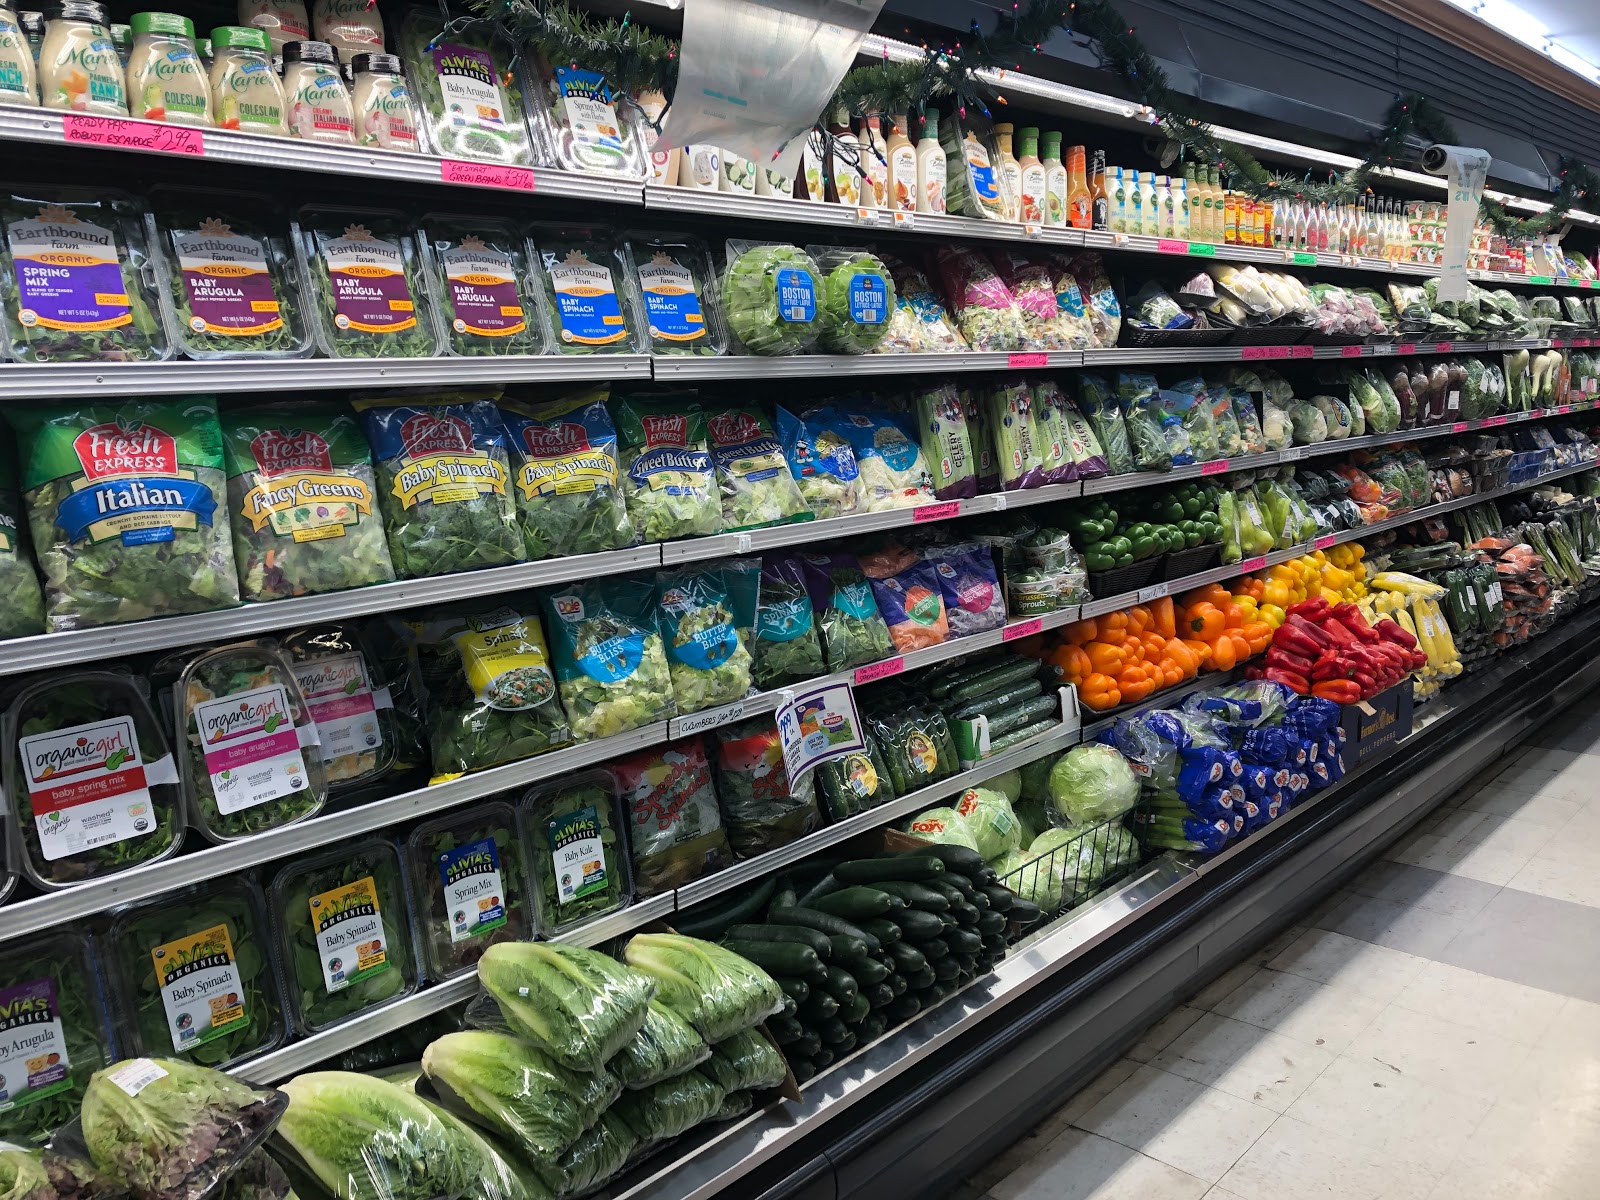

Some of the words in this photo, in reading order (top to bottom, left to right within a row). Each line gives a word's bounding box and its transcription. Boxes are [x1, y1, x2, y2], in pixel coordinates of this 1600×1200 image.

[443, 67, 492, 84] ORGANICS
[90, 81, 123, 99] RANCH
[446, 82, 465, 97] Baby
[466, 86, 495, 99] Arugula
[164, 91, 207, 107] COLESLAW
[574, 100, 593, 114] Spring
[594, 104, 607, 114] Mix
[239, 102, 280, 117] COLESLAW
[312, 107, 333, 116] CREAMY
[71, 116, 105, 129] READY
[313, 113, 337, 123] ITALIAN
[69, 129, 105, 142] ROBUST
[389, 123, 407, 132] ITALIAN
[449, 173, 474, 183] GREEN
[475, 174, 501, 184] BEANS
[13, 225, 109, 247] Earthbound
[50, 239, 80, 250] Farm
[180, 239, 260, 257] Earthbound
[328, 243, 397, 259] Earthbound
[39, 254, 93, 265] ORGANIC
[211, 252, 235, 262] Farm
[355, 254, 376, 264] Farm
[446, 252, 508, 269] Earthbound
[23, 266, 70, 278] SPRING
[203, 266, 247, 275] ORGANIC
[348, 267, 386, 276] ORGANIC
[470, 263, 489, 273] Farm
[553, 267, 608, 281] Earthbound
[640, 267, 690, 281] Earthbound
[25, 277, 49, 287] MIX
[190, 278, 216, 287] BABY
[336, 278, 360, 287] BABY
[464, 275, 499, 284] ORGANIC
[574, 277, 592, 285] Farm
[659, 276, 675, 284] Farm
[194, 287, 244, 297] ARUGULA
[339, 286, 384, 296] ARUGULA
[453, 285, 474, 294] BABY
[782, 286, 811, 300] BOSTON
[854, 291, 883, 303] BOSTON
[456, 293, 496, 303] ARUGULA
[561, 298, 579, 306] BABY
[647, 296, 664, 304] BABY
[562, 305, 595, 313] SPINACH
[649, 303, 678, 311] SPINACH
[411, 416, 461, 442] Fresh
[649, 416, 683, 432] Fresh
[714, 415, 749, 435] Fresh
[89, 428, 163, 458] Fresh
[529, 425, 577, 447] Fresh
[650, 431, 682, 443] EXPRESS
[1020, 425, 1029, 460] CELERY
[262, 433, 321, 460] Fresh
[414, 438, 468, 453] EXPRESS
[533, 442, 581, 456] EXPRESS
[948, 431, 963, 468] CELERY
[94, 455, 167, 473] EXPRESS
[265, 456, 323, 472] EXPRESS
[637, 454, 667, 474] Sweet
[666, 452, 708, 471] Butter
[716, 447, 744, 465] Sweet
[401, 462, 438, 494] Baby
[437, 458, 500, 483] Spinach
[525, 464, 556, 486] Baby
[554, 454, 614, 478] Spinach
[95, 482, 184, 514] Italian
[252, 484, 297, 514] Fancy
[297, 479, 365, 500] Greens
[557, 600, 581, 614] Dole
[1018, 599, 1046, 610] Sprouts
[692, 623, 726, 644] BUTTER
[702, 632, 726, 651] BLISS
[588, 635, 623, 657] BUTTER
[599, 644, 625, 664] BLISS
[208, 696, 280, 734] organicgirl
[1373, 730, 1396, 749] PEPPERS
[36, 730, 125, 771] organicgirl
[228, 747, 247, 758] baby
[248, 739, 276, 753] arugula
[52, 786, 75, 800] baby
[77, 779, 107, 794] spring
[109, 774, 126, 785] mix
[217, 774, 239, 792] organic
[655, 768, 711, 831] Spinach
[43, 815, 71, 836] organic
[557, 829, 595, 848] ORGANICS
[564, 849, 579, 862] Baby
[580, 844, 593, 856] Kale
[449, 863, 493, 883] ORGANICS
[454, 885, 478, 900] Spring
[478, 878, 493, 891] Mix
[322, 904, 372, 929] ORGANICS
[325, 933, 346, 947] Baby
[345, 919, 377, 940] Spinach
[167, 954, 227, 982] ORGANICS
[172, 986, 195, 1002] Baby
[195, 970, 232, 993] Spinach
[0, 996, 49, 1019] VIA'S
[0, 1011, 49, 1031] GANICS
[11, 1029, 55, 1053] Arugula
